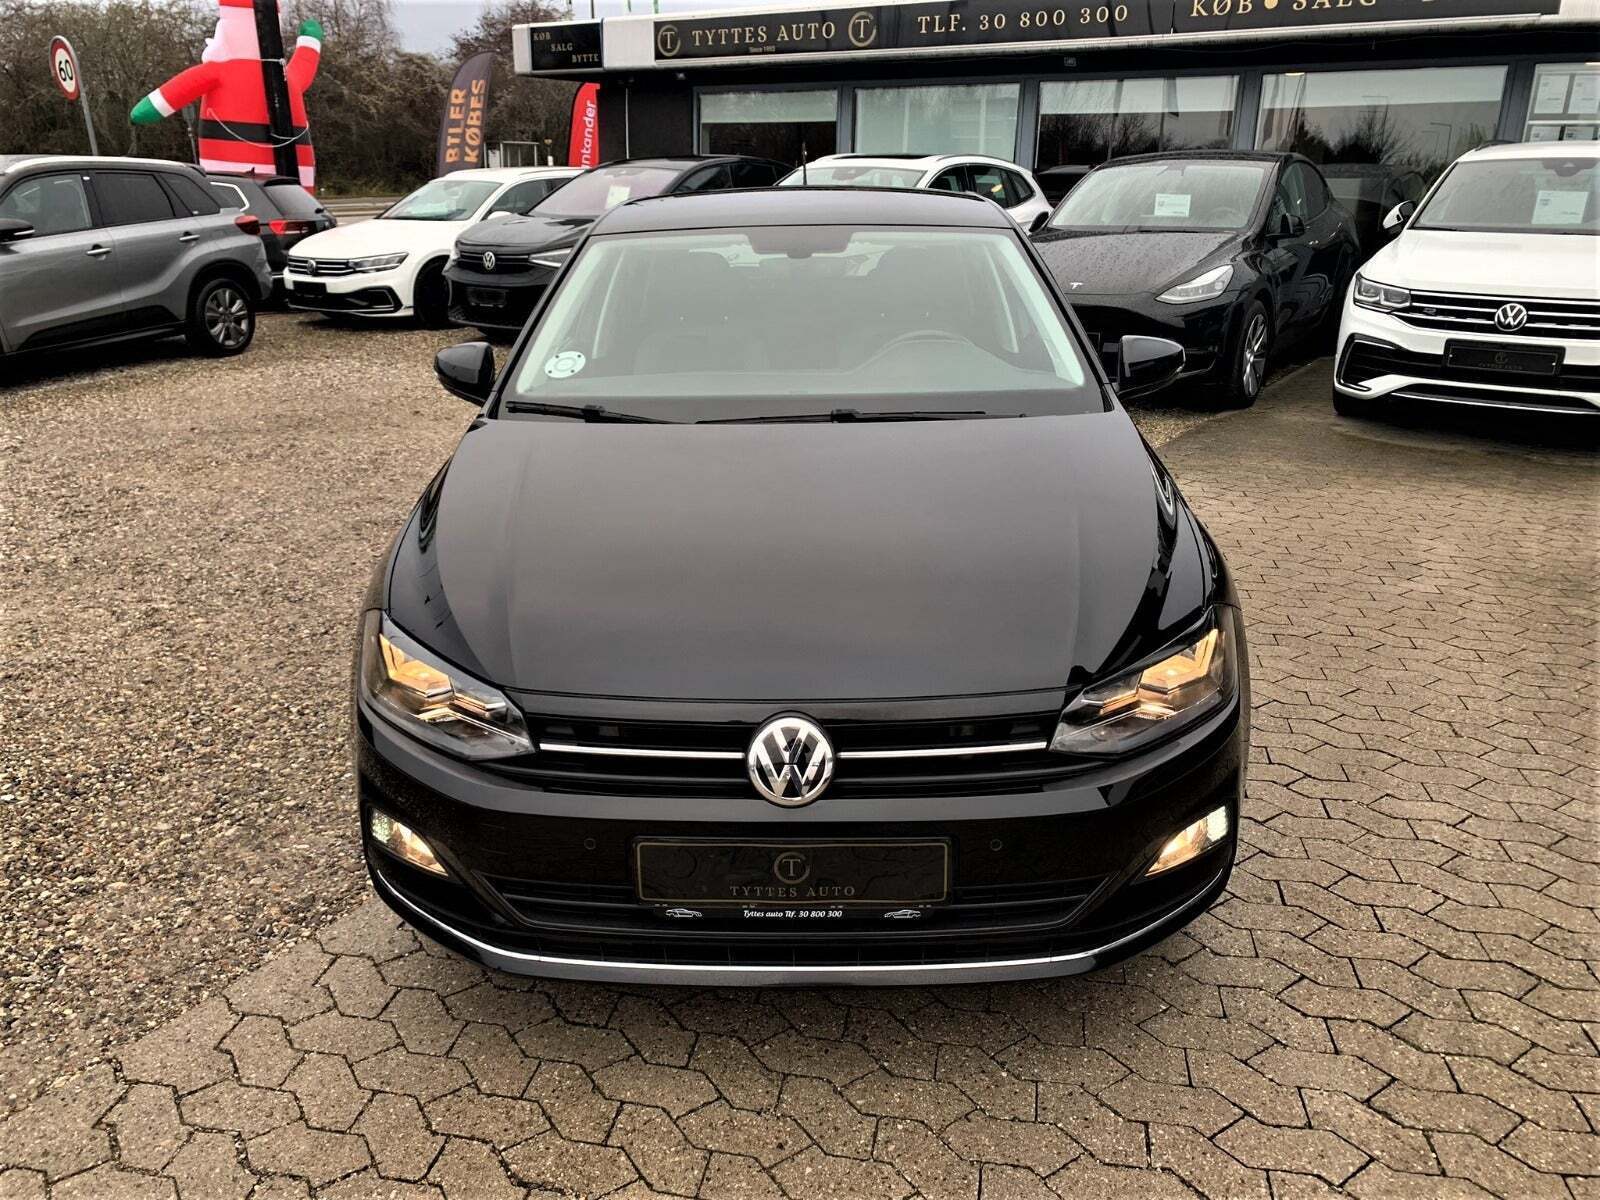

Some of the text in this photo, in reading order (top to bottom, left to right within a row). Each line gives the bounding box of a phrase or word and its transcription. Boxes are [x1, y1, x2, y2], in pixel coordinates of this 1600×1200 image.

[917, 4, 1128, 34] TLF. 30 800 300
[691, 21, 836, 47] TYTTES AUTO
[550, 42, 573, 52] SALG
[571, 53, 600, 63] BYTTE
[58, 59, 73, 82] 60
[463, 79, 486, 163] KØBES
[729, 886, 856, 897] TYTTES AUTO
[743, 909, 765, 919] Tyttes
[798, 910, 809, 918] 30
[809, 910, 826, 918] 800
[826, 910, 843, 918] 300
